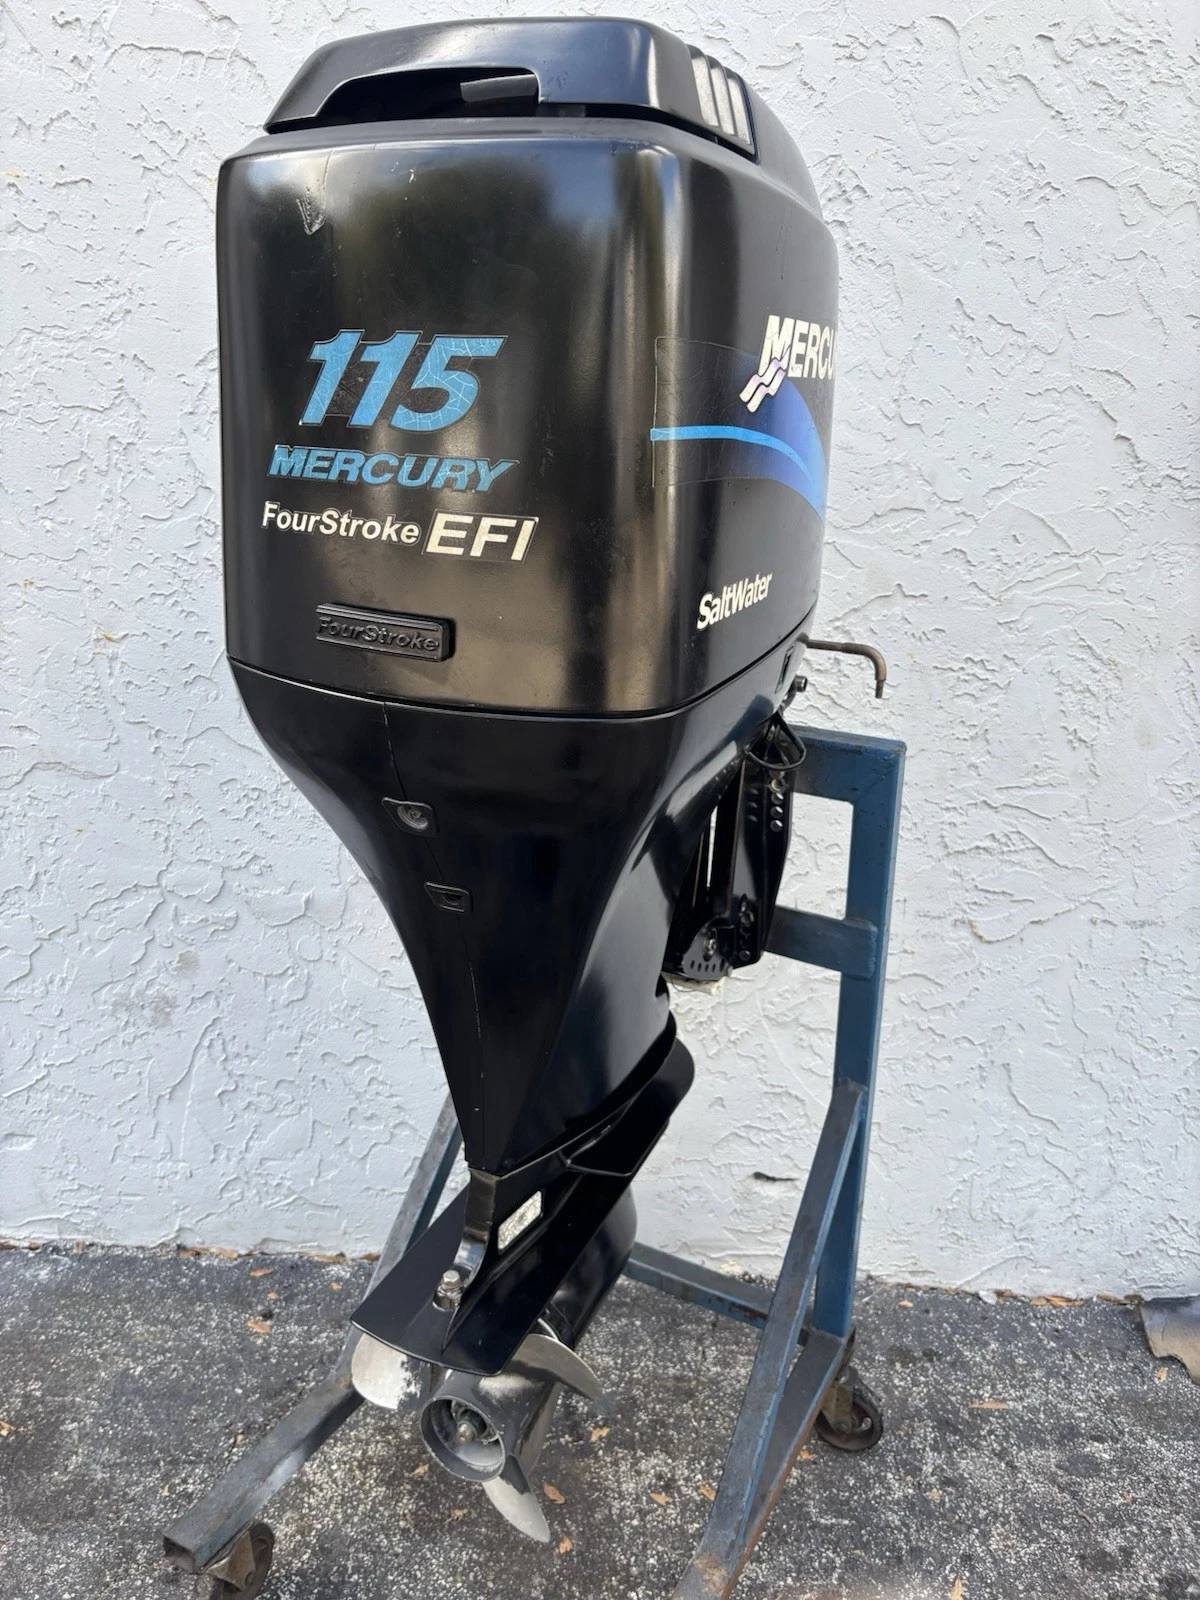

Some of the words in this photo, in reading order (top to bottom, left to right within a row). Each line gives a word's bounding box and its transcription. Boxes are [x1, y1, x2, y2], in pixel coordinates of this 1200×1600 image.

[301, 329, 506, 432] 115
[268, 446, 517, 492] MERCURY
[262, 501, 420, 544] FourStroke
[425, 512, 538, 561] EFI
[696, 573, 773, 630] SaltWater
[317, 615, 440, 651] FourStroke
